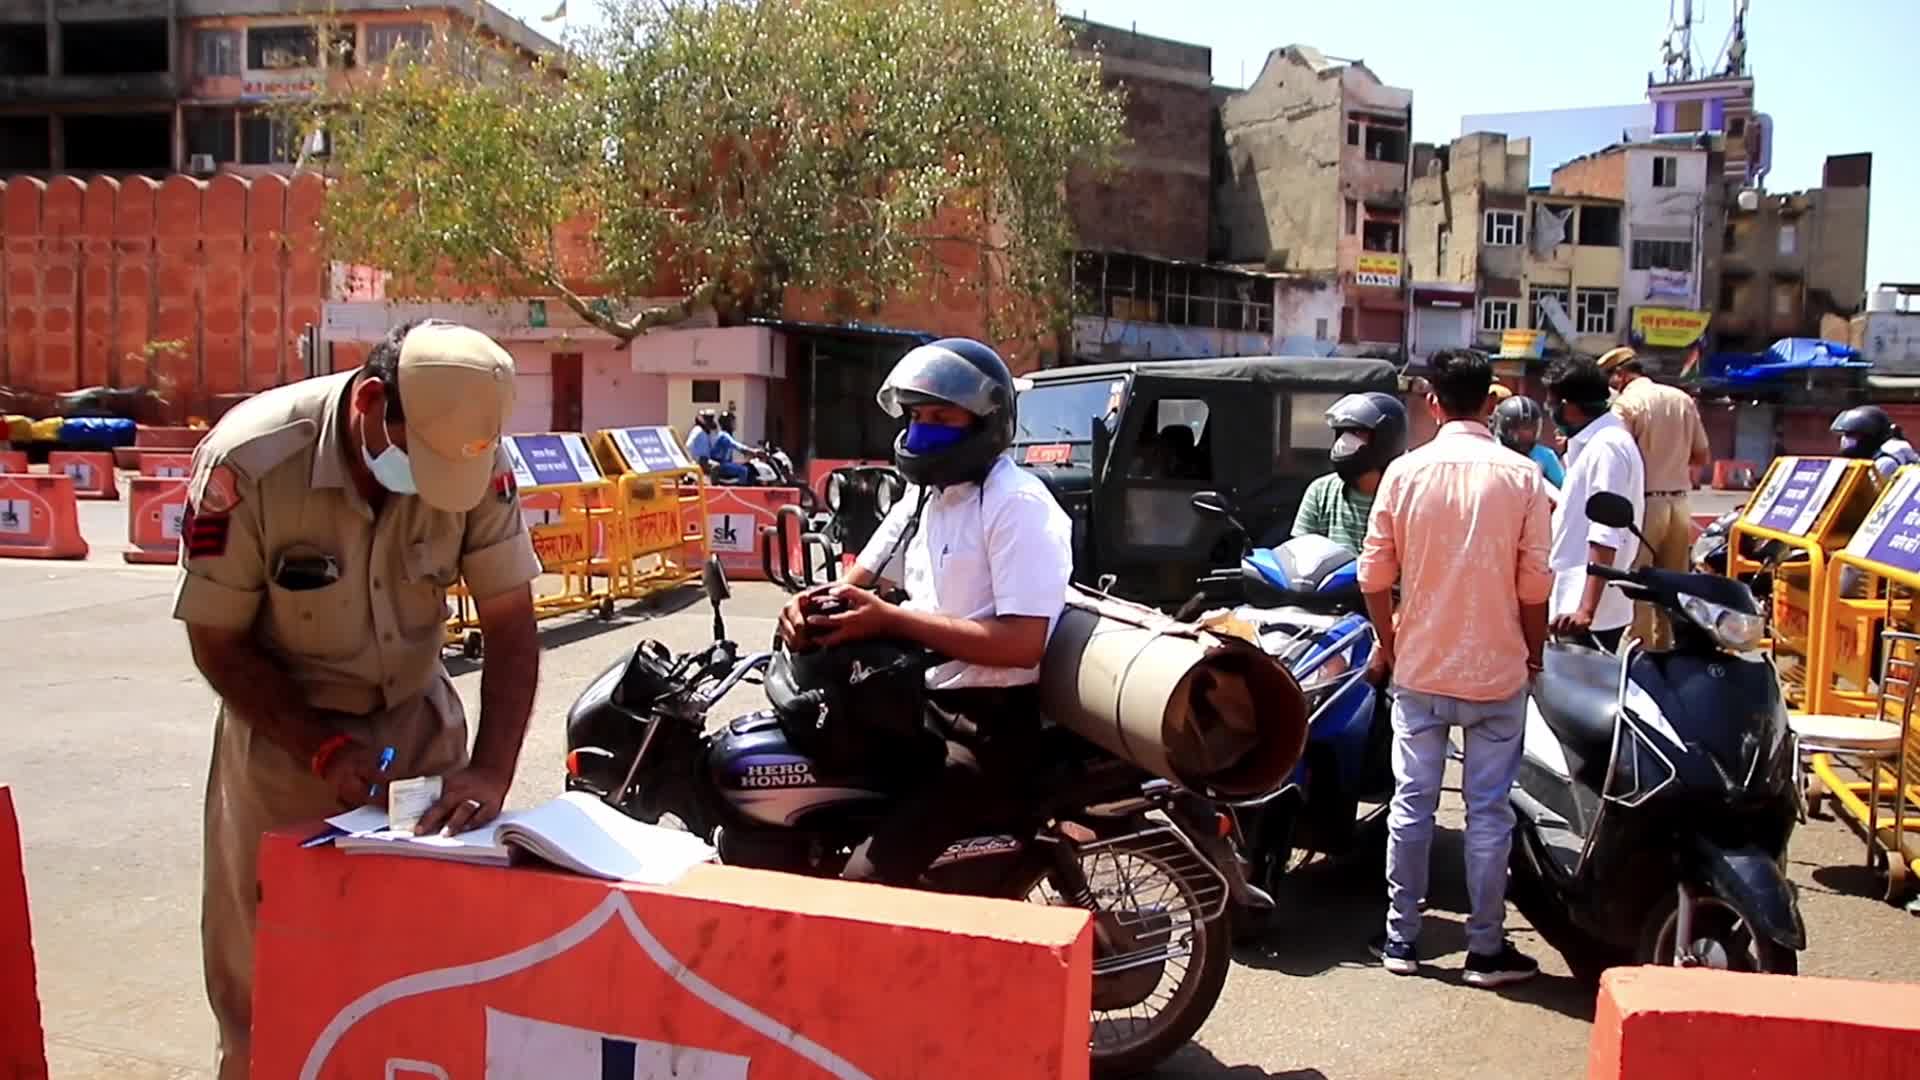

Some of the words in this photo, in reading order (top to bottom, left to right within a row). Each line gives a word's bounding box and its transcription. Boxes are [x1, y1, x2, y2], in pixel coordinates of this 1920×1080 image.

[713, 514, 737, 541] sk
[748, 763, 809, 776] HERO
[740, 773, 817, 787] HONDA
